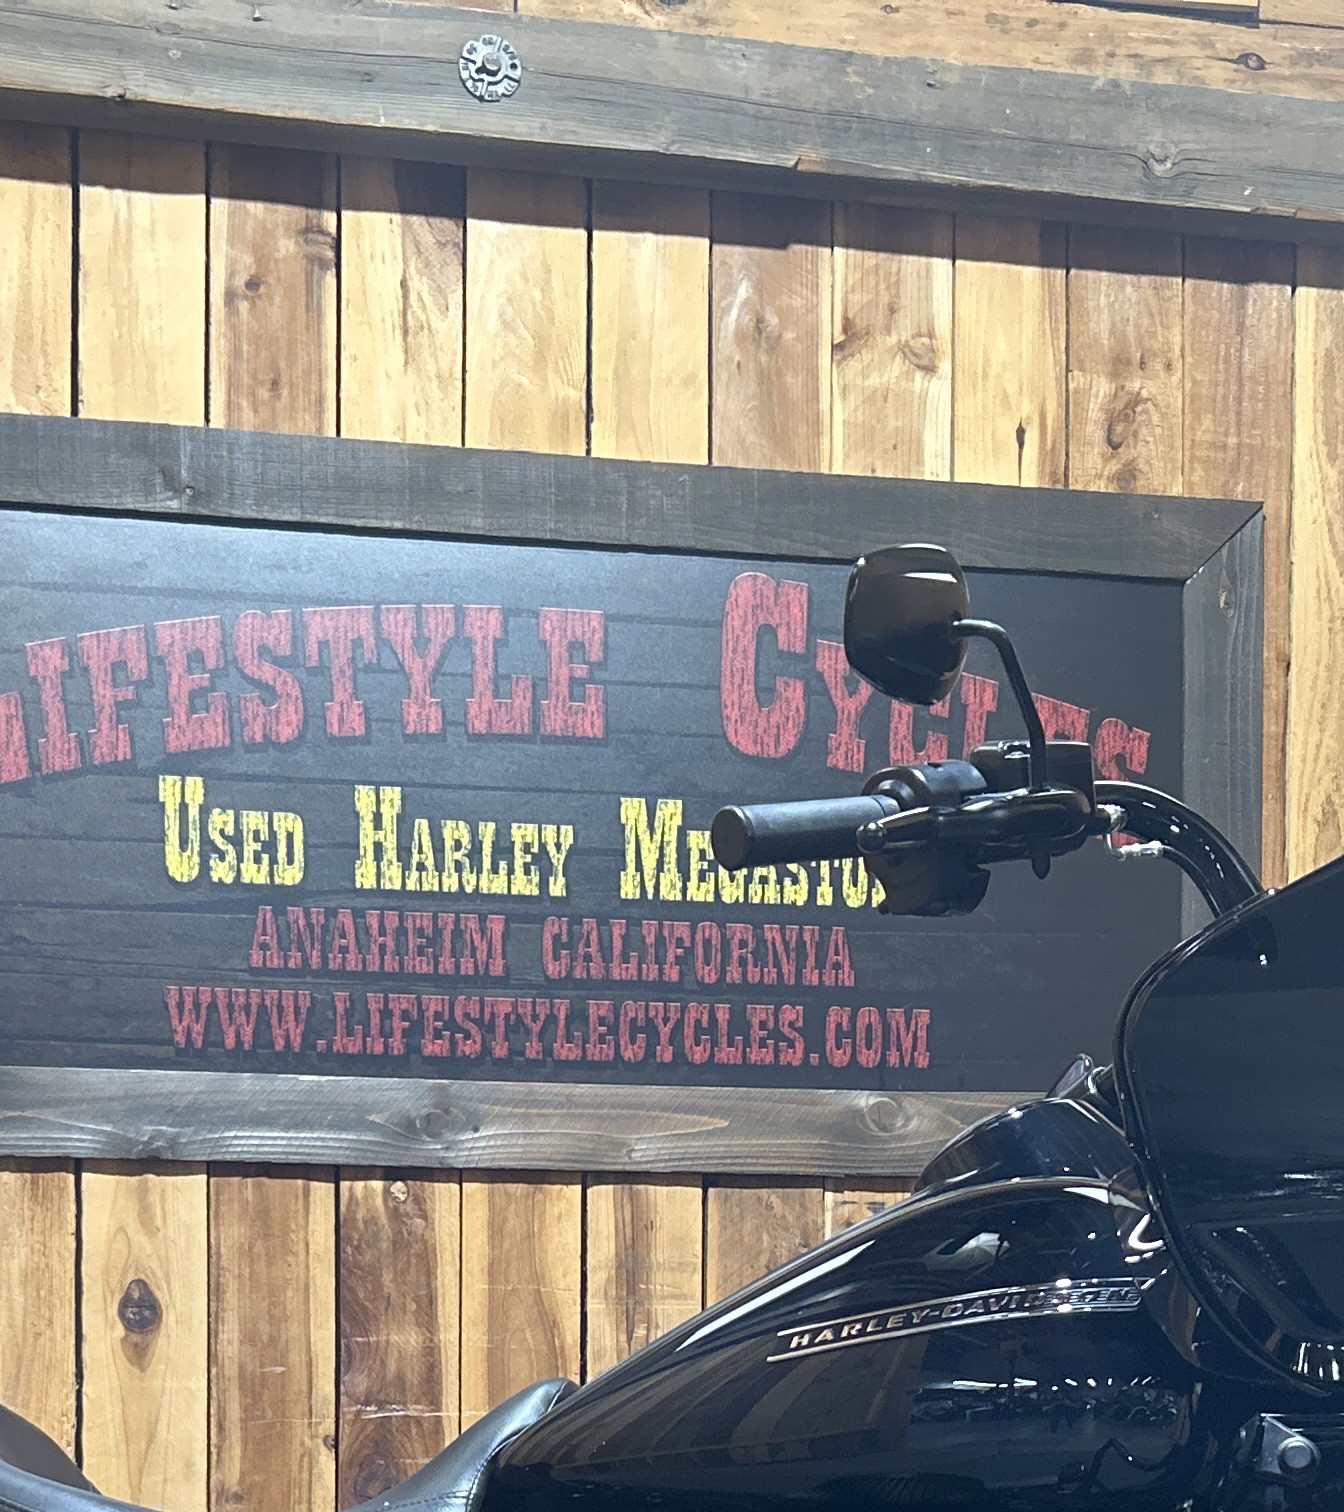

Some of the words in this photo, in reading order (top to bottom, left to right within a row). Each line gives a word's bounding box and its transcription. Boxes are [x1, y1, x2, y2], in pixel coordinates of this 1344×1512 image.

[159, 775, 305, 885] USED
[355, 785, 573, 898] HARLEY
[249, 905, 507, 977] ANAHEIM
[541, 916, 856, 987] CALIFORNIA
[164, 984, 932, 1069] WWW.LIFESTYLECYCLES.COM
